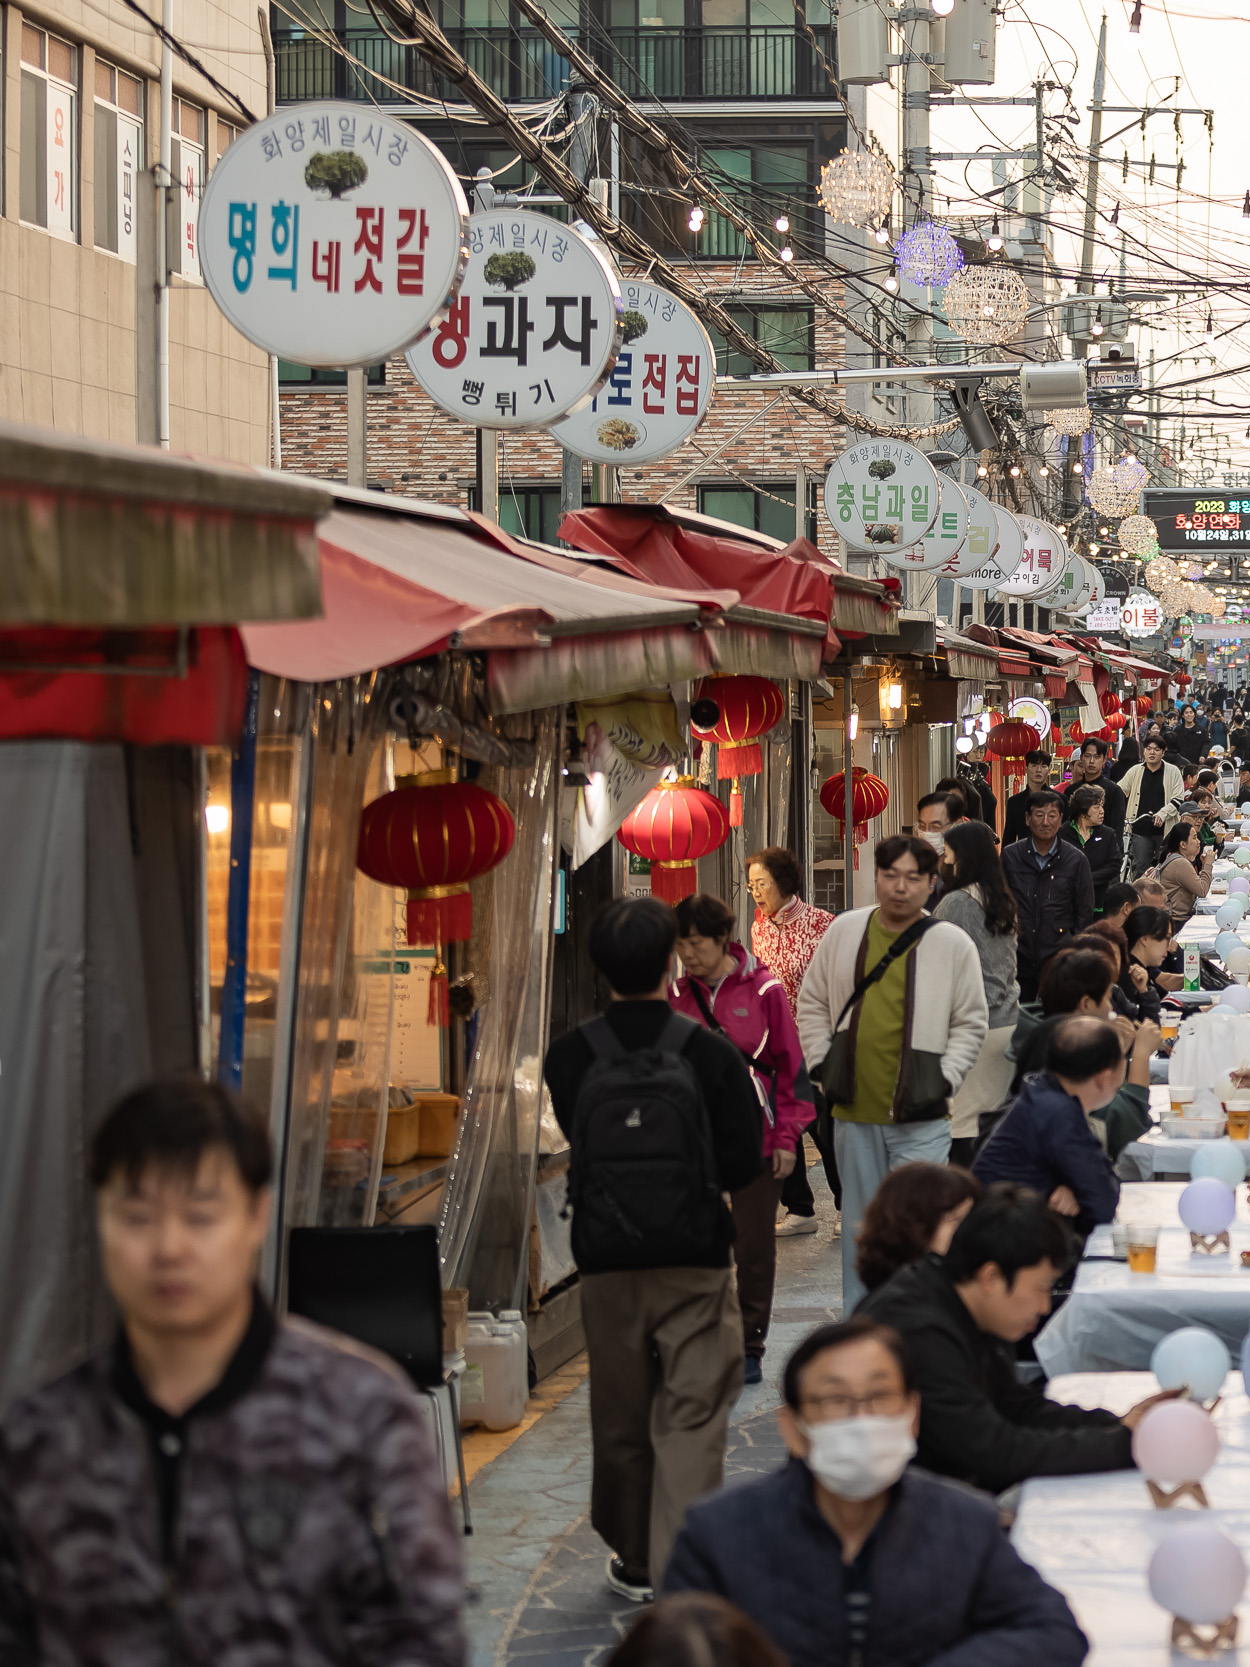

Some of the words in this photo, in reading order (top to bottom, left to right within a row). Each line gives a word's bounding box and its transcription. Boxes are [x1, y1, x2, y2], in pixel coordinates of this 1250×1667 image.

[260, 114, 409, 167] 화양제일시장
[469, 222, 570, 263] 양제일시장
[627, 286, 677, 323] 일시장
[461, 378, 557, 417] 뻥튀기
[591, 352, 701, 416] 로전집
[849, 444, 914, 467] 화양제일시장
[836, 481, 929, 523] 충남과일
[1194, 501, 1225, 513] 2023
[1019, 519, 1041, 536] 일시장
[965, 567, 1002, 580] more
[1008, 573, 1040, 585] 구이김
[1122, 608, 1159, 628] 이불
